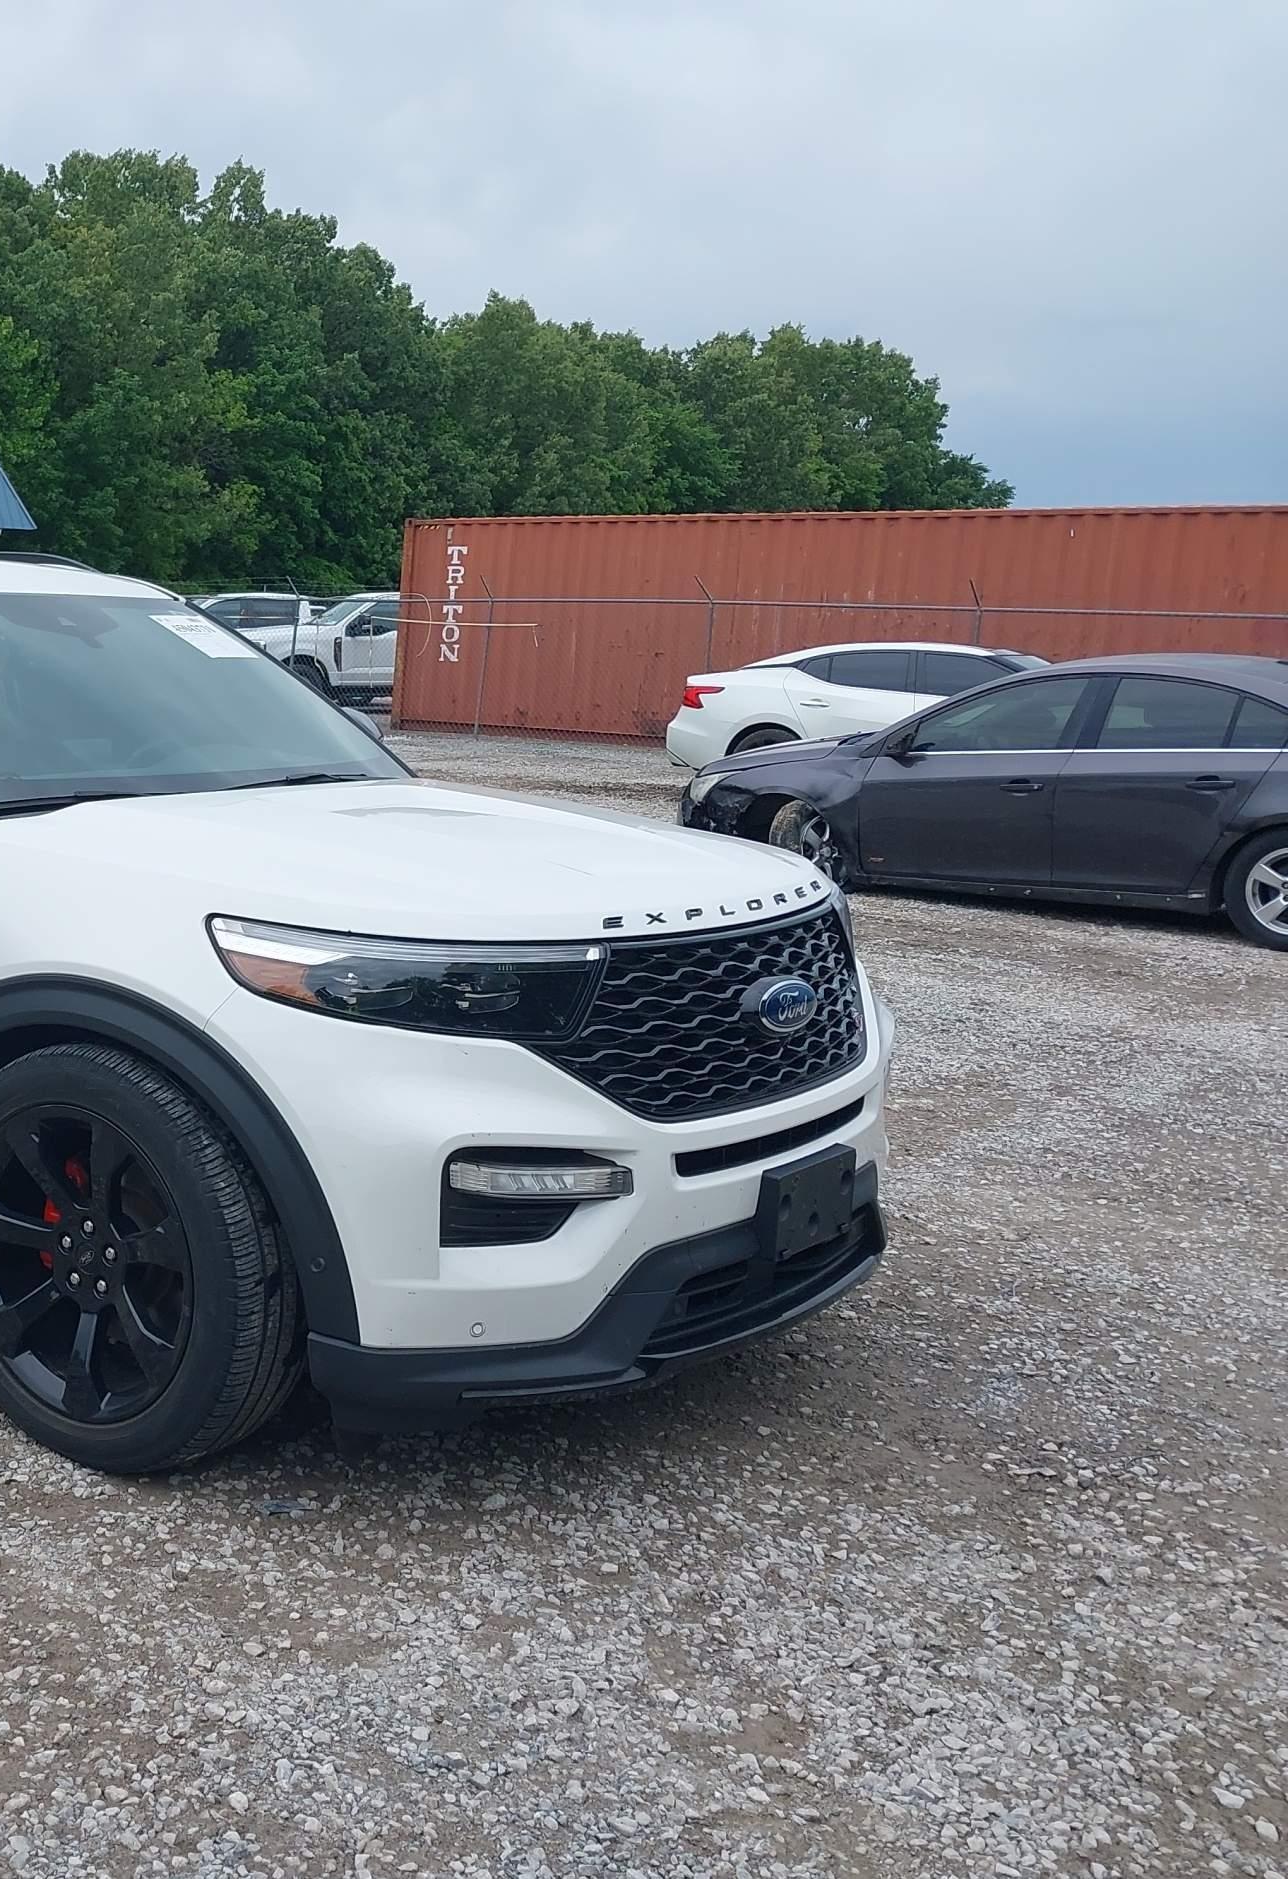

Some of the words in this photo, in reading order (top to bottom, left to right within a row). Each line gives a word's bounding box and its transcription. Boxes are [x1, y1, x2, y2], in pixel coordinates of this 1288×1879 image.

[438, 545, 468, 663] TRITON
[602, 880, 822, 930] EXPLORER
[778, 990, 808, 1021] Ford
